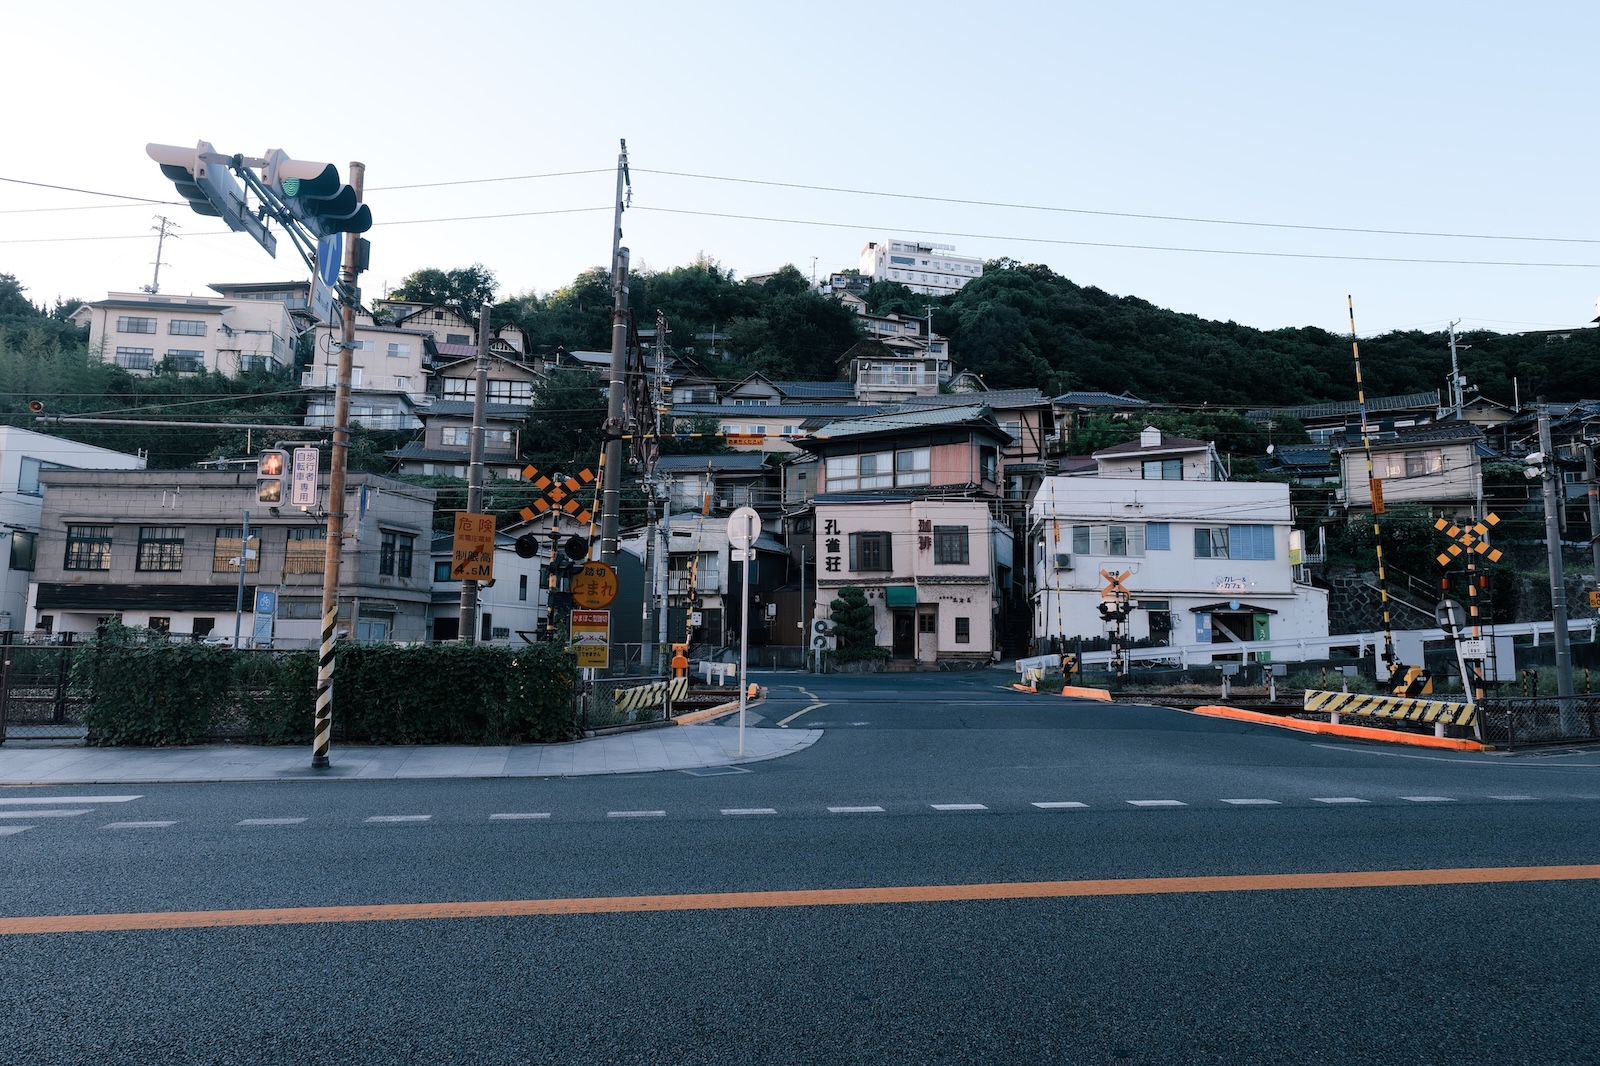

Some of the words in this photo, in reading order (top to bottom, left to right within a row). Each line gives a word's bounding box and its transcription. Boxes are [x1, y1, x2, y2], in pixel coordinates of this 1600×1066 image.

[296, 452, 306, 481] 自転車
[306, 452, 316, 482] 歩行者
[300, 482, 309, 502] 専用
[458, 516, 493, 534] 危険
[918, 519, 932, 551] 珈琲
[824, 519, 841, 572] 孔雀荘
[455, 550, 491, 562] 制限高
[455, 564, 490, 576] 4.5M
[584, 566, 606, 578] 踏切
[572, 579, 614, 597] とまれ
